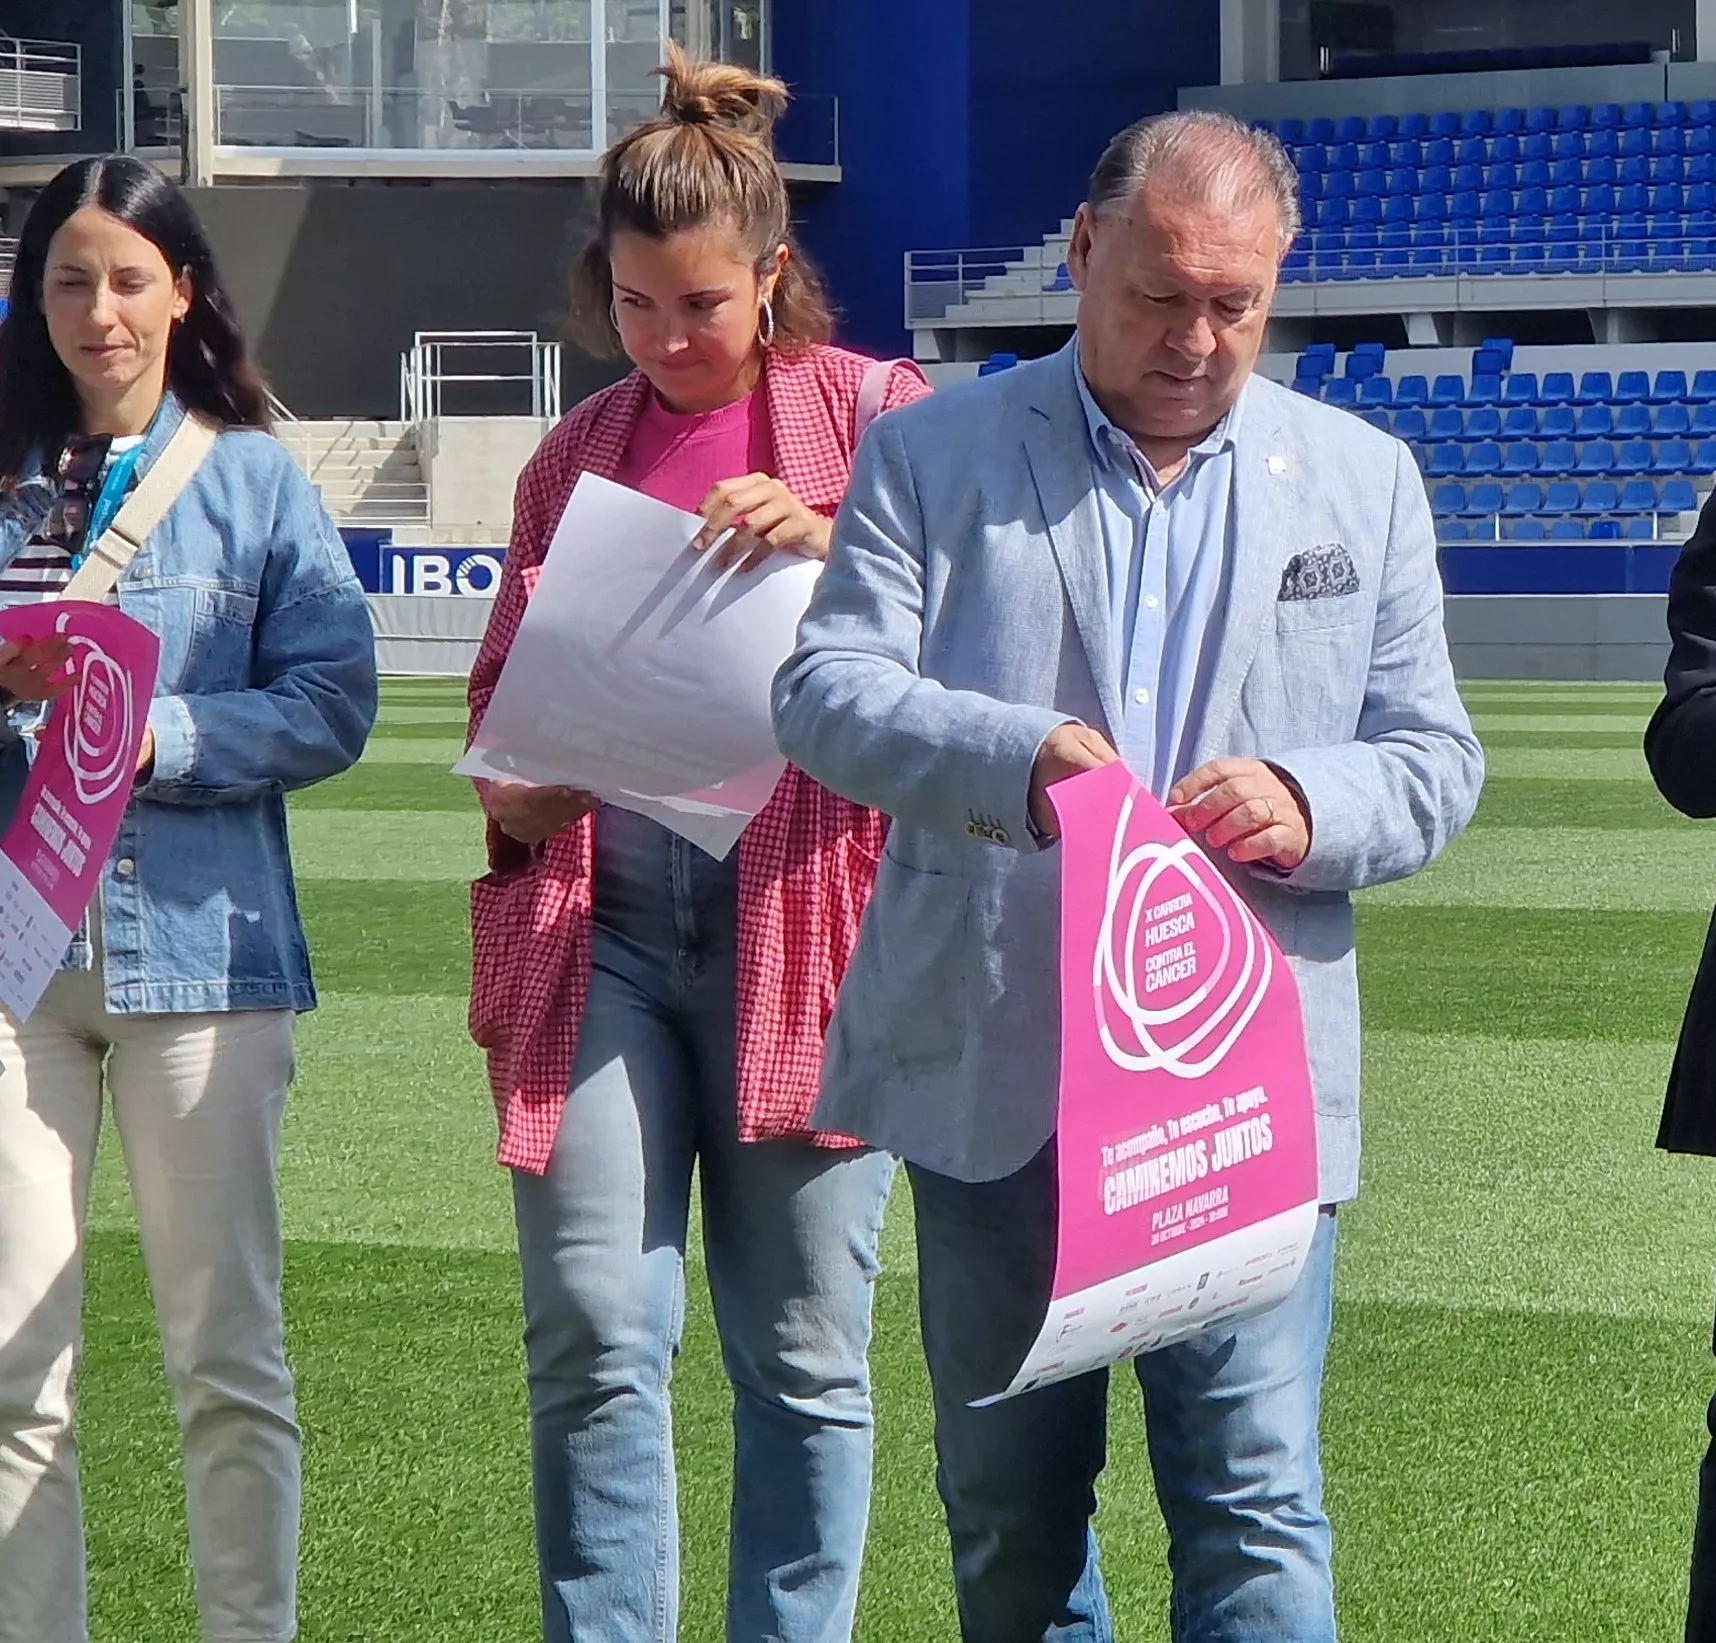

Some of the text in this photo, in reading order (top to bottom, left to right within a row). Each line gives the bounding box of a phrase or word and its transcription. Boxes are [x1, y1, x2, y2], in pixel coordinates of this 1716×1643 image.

[1145, 892, 1193, 923] X CARRERA
[1145, 912, 1195, 947] HUESCA
[1145, 941, 1196, 973] CONTRA EL
[1145, 960, 1197, 993] CANCER
[1101, 1145, 1114, 1168] Te
[1167, 1118, 1180, 1141] Te
[1222, 1096, 1235, 1118] Te
[1103, 1113, 1274, 1216] CAMINEMOS JUNTOS
[1152, 1185, 1229, 1232] PLAZA NAVARRA
